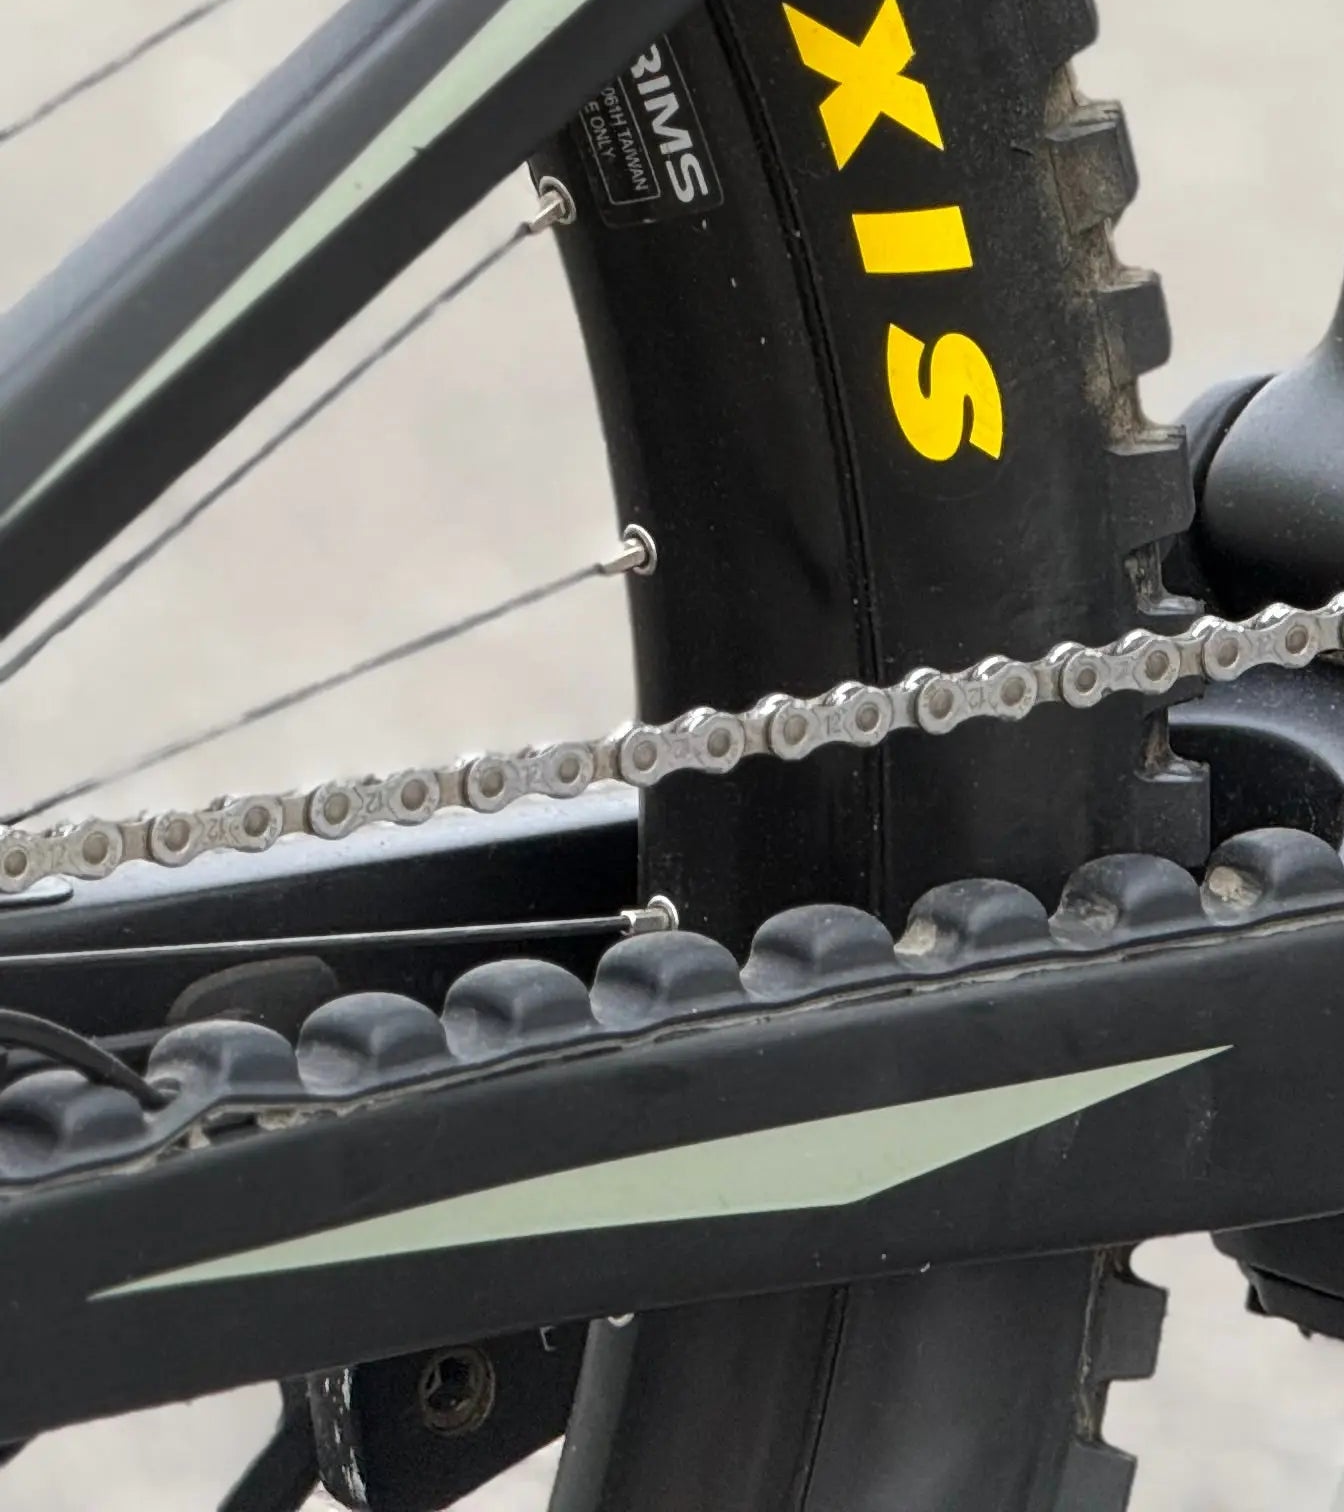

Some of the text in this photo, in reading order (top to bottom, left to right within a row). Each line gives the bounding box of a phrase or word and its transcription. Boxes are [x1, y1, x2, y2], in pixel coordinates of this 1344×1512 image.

[590, 116, 616, 159] ONLY
[601, 87, 649, 192] 061H TAIWAN
